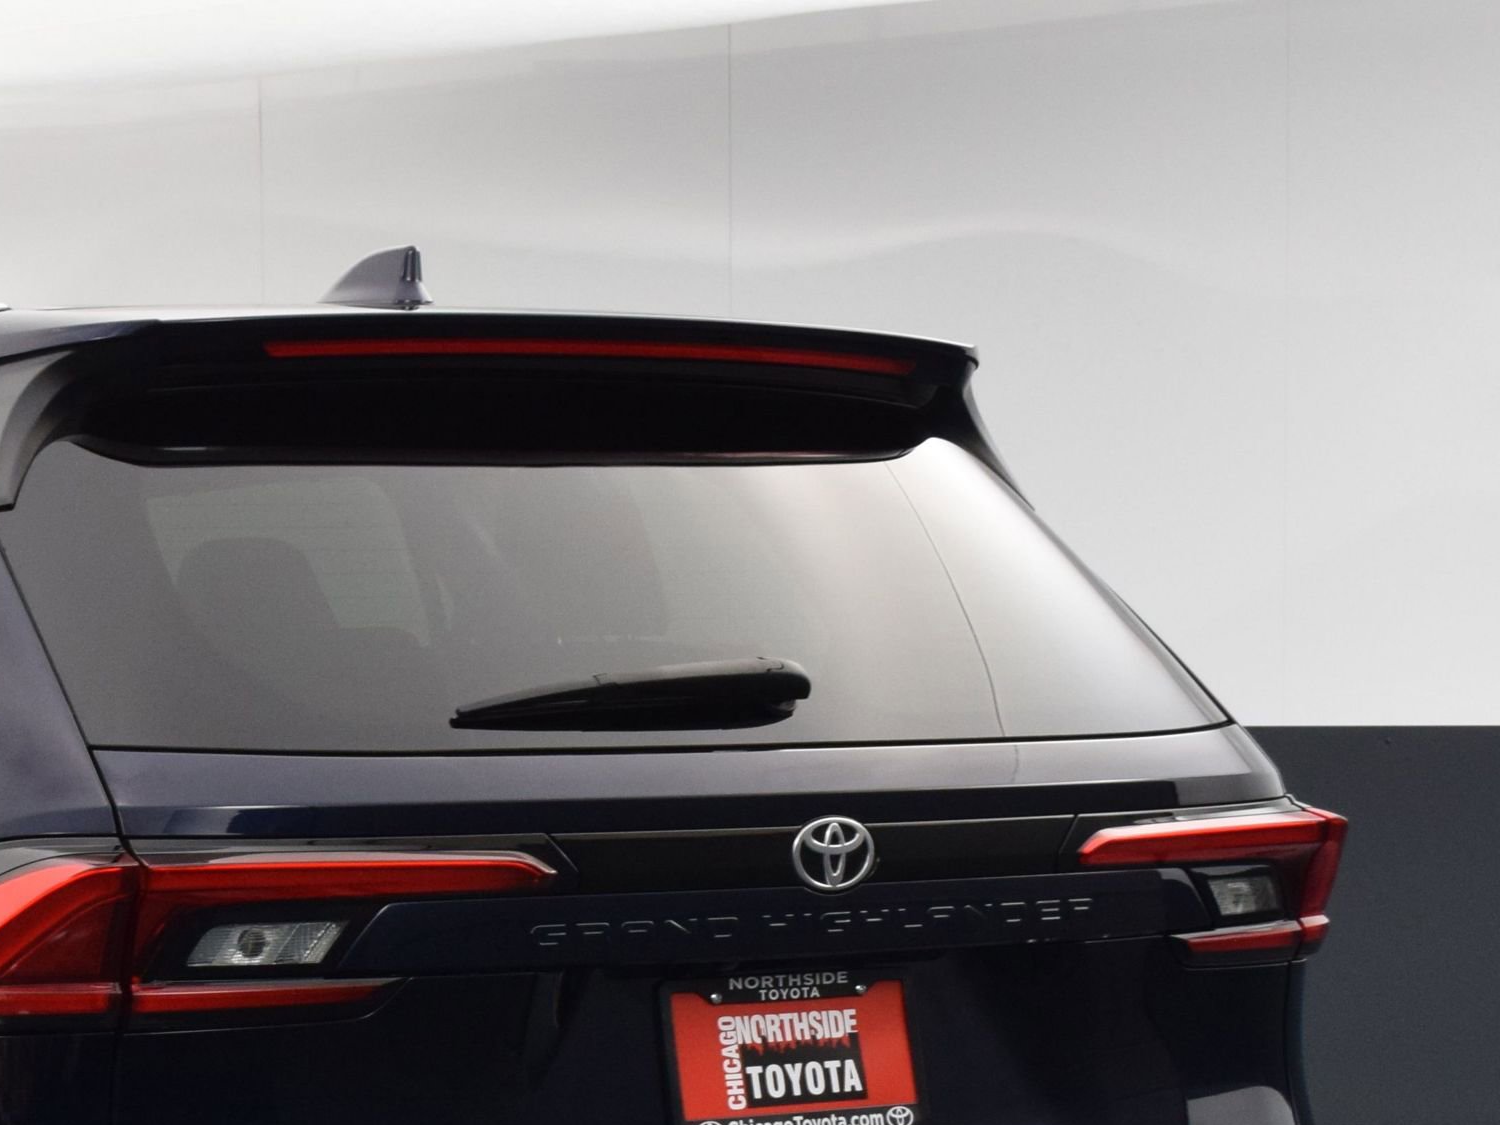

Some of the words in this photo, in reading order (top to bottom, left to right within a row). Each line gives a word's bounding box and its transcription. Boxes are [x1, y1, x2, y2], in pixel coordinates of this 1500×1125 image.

[530, 915, 740, 948] GRAND
[759, 897, 1093, 938] HIGHLANDER
[728, 971, 849, 991] NORTHSIDE
[758, 987, 821, 1001] TOYOTA
[735, 1008, 859, 1045] NORTHSIDE
[717, 1015, 747, 1110] CHICAGO
[745, 1059, 863, 1099] TOYOTA
